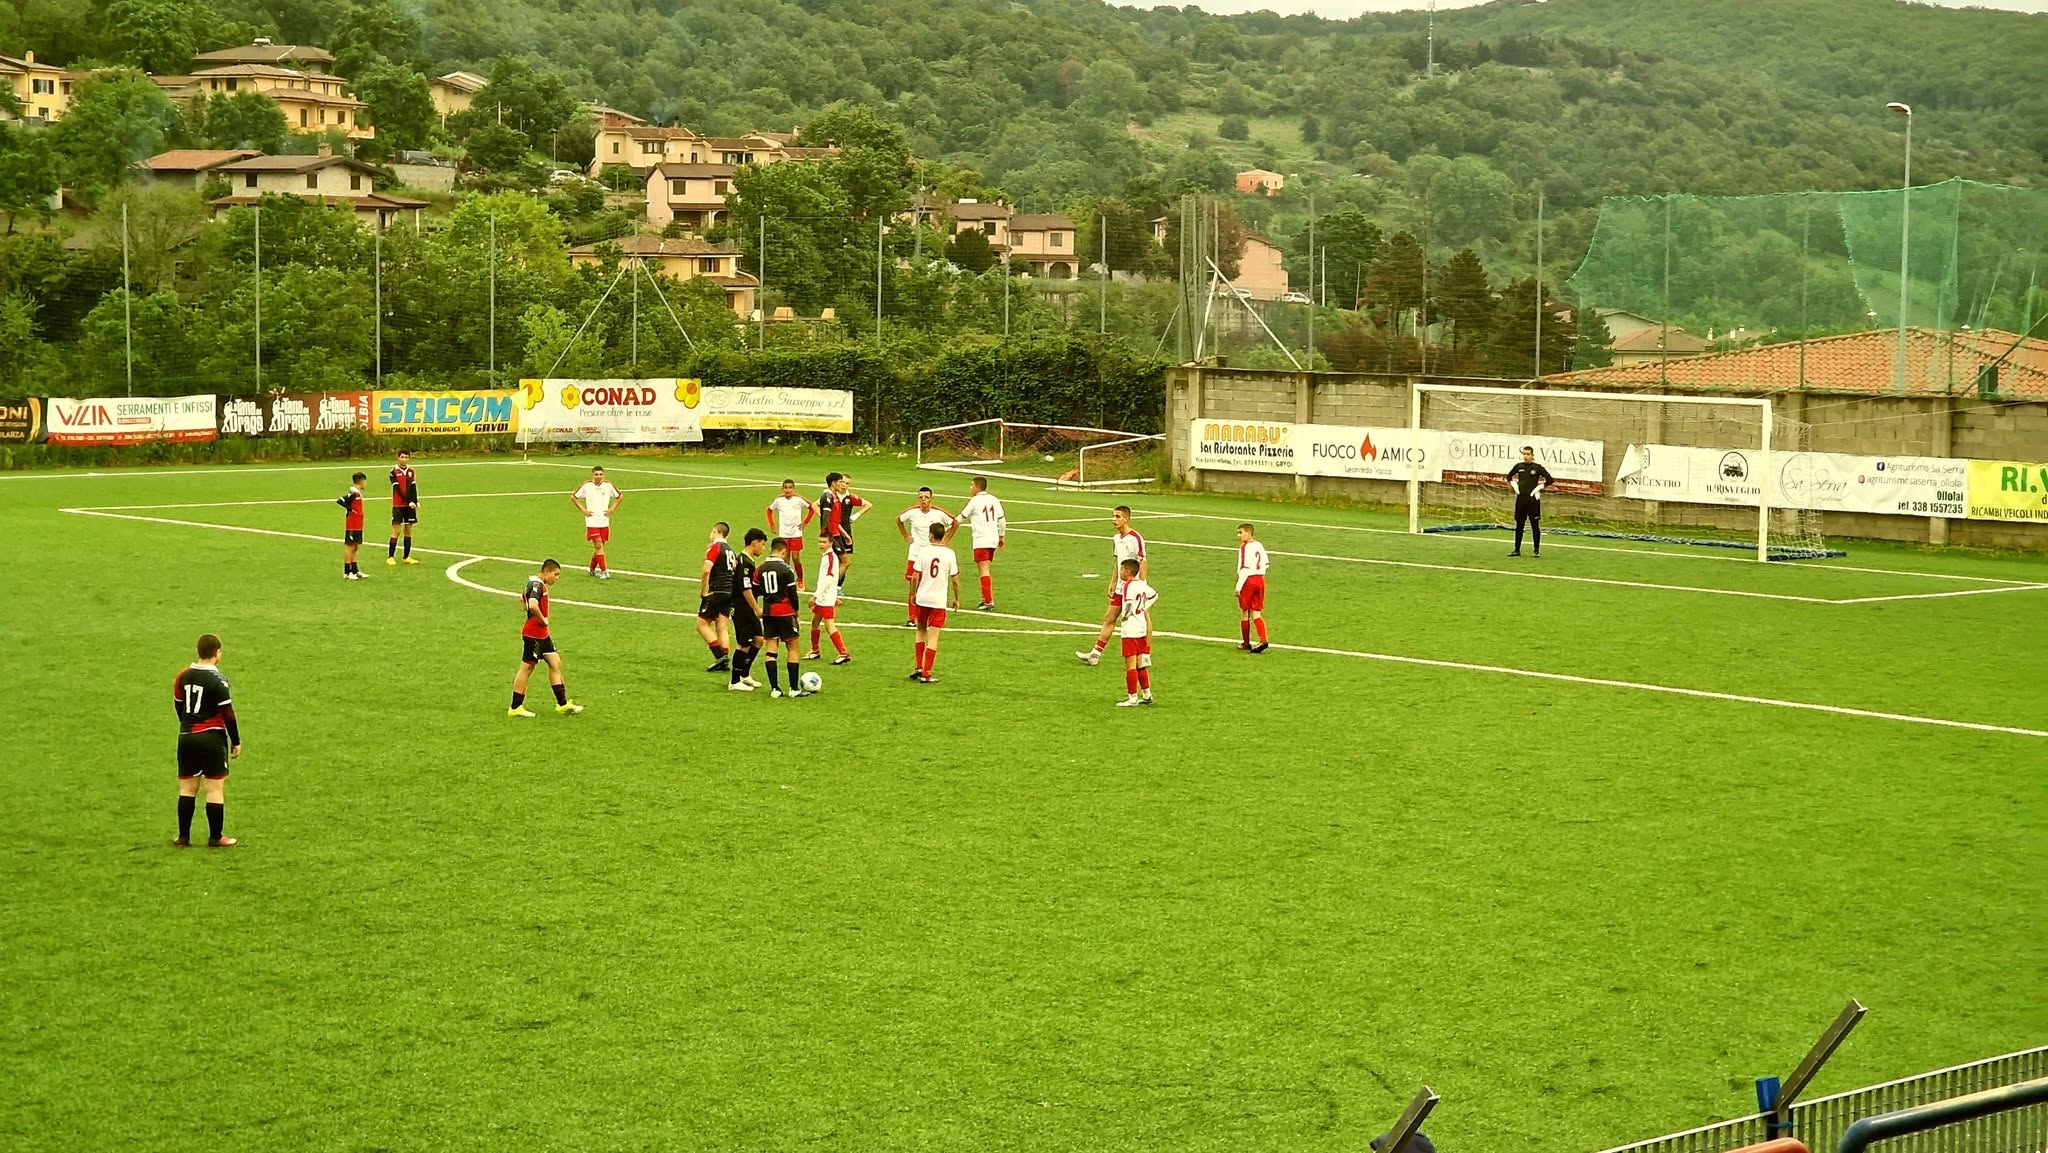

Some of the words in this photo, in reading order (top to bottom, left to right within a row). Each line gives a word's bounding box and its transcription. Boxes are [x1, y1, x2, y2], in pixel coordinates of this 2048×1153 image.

[280, 397, 303, 414] Tana
[328, 396, 350, 413] Tana
[581, 387, 657, 406] CONAD
[777, 391, 823, 410] Giuseppe
[117, 402, 172, 416] SERRAMENTI
[174, 402, 179, 414] E
[182, 401, 213, 413] INFISSI
[233, 398, 256, 415] Tana
[378, 394, 513, 424] SEICOM
[579, 408, 605, 417] Persone
[229, 412, 264, 435] Drago
[276, 411, 311, 434] Drago
[474, 422, 509, 433] GAVOI
[1200, 441, 1212, 454] Bar
[1213, 441, 1257, 456] Ristorante
[1259, 443, 1294, 458] Pizzeria
[1312, 443, 1356, 460] FUOCO
[1381, 447, 1425, 463] AMICO
[1468, 442, 1515, 460] HOTEL
[1540, 447, 1597, 467] VALASA
[1344, 465, 1373, 474] Leonardo
[1886, 462, 1930, 474] Agriturismo
[1930, 464, 1941, 474] Sa
[1942, 464, 1965, 475] Serra
[982, 504, 995, 523] 11
[1912, 501, 1928, 512] 338
[1930, 502, 1963, 514] 1557235
[1971, 506, 2002, 518] RICAMBI
[2003, 508, 2033, 519] VEICOLI
[929, 557, 940, 579] 6
[1254, 551, 1262, 570] 2
[761, 570, 779, 594] 10
[183, 684, 204, 714] 17
